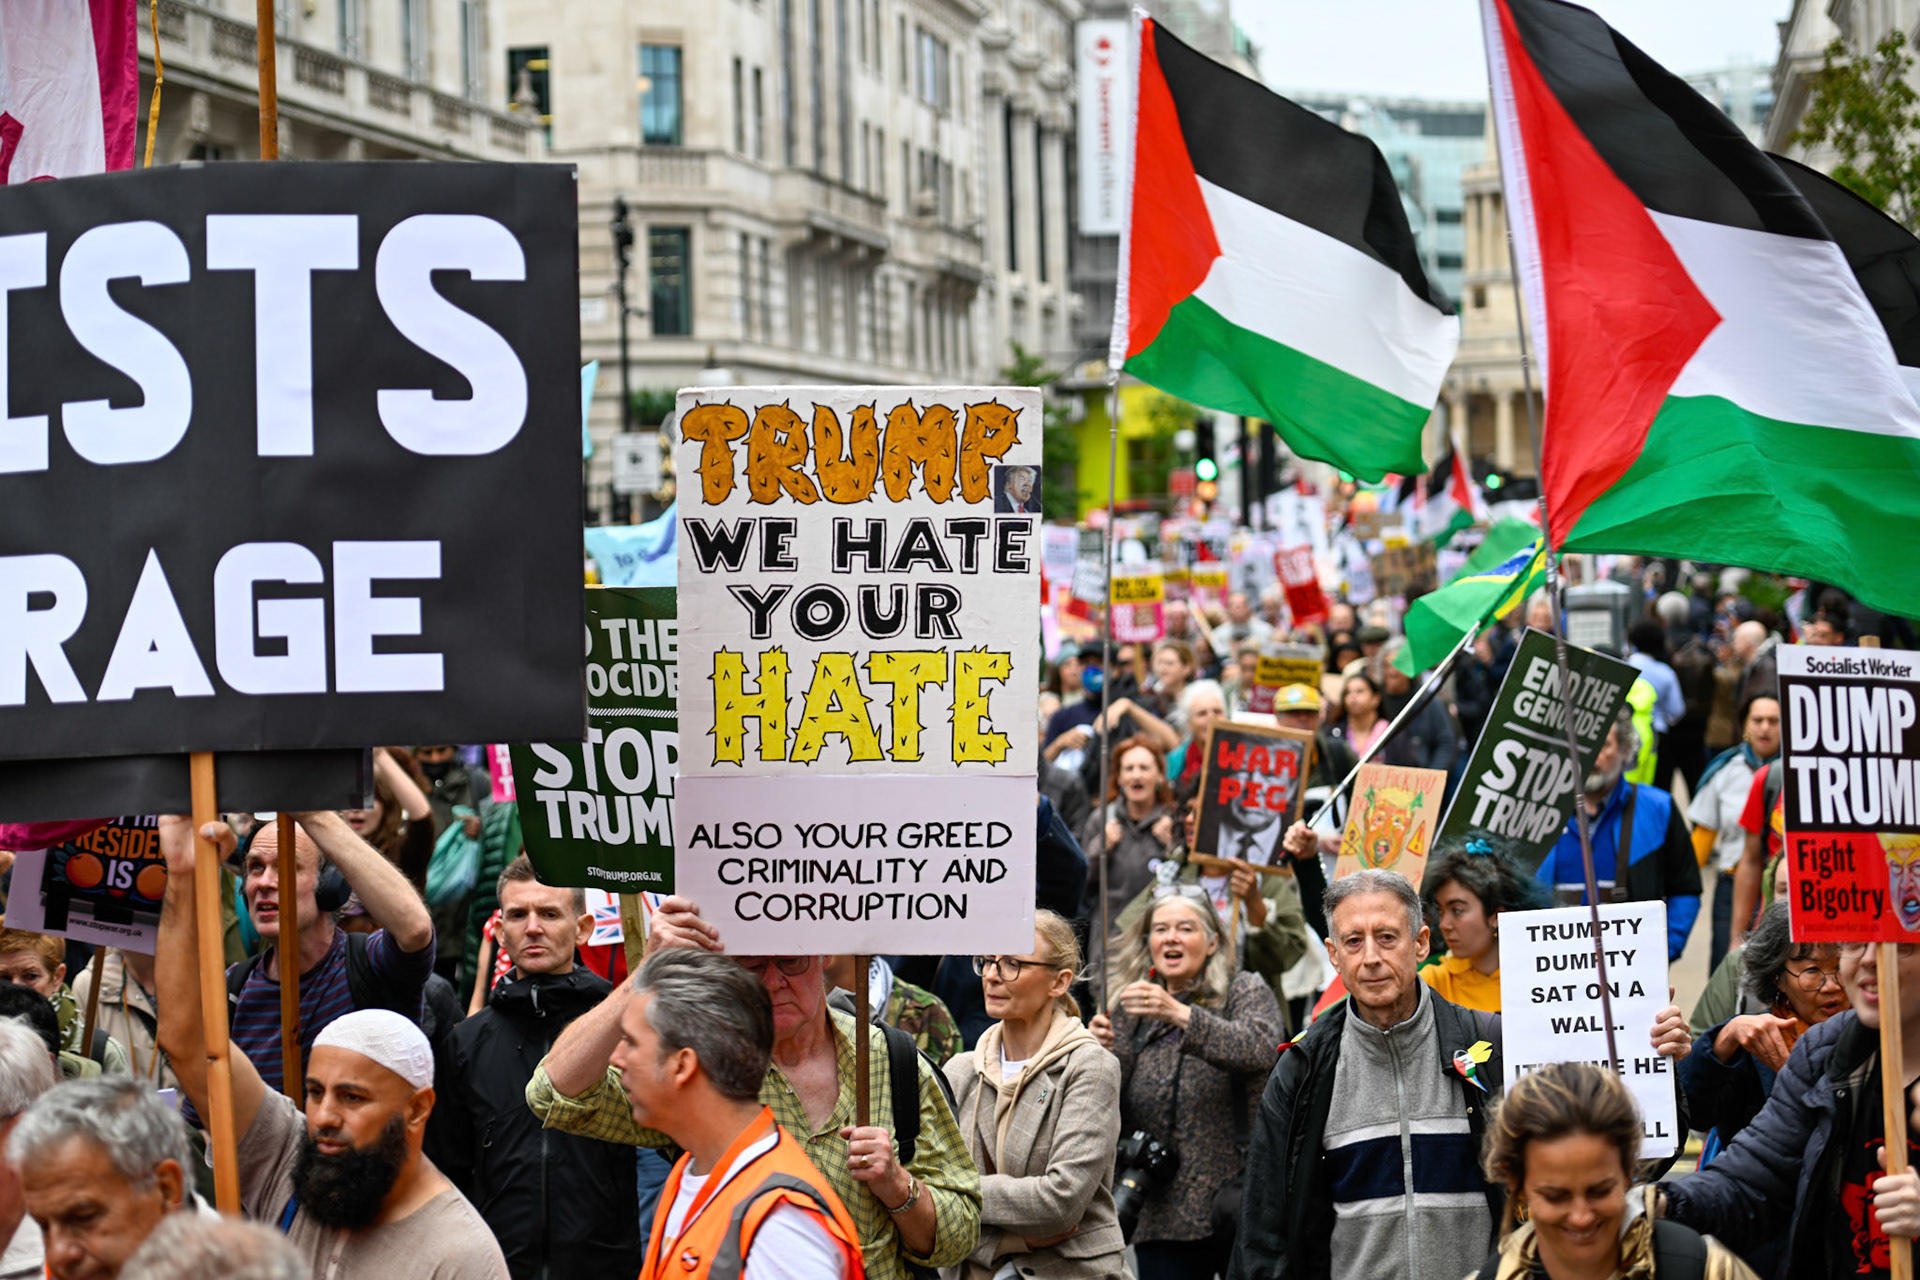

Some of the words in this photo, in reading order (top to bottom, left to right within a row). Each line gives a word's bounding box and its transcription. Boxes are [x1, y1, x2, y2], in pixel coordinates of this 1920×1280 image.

[680, 397, 1024, 505] TRUMP
[683, 517, 798, 573] WE
[832, 517, 1033, 574] HATE
[0, 540, 444, 705] RAGE
[726, 583, 963, 641] YOUR
[600, 618, 678, 661] THE
[1522, 656, 1581, 702] END
[1575, 676, 1621, 714] THE
[1806, 656, 1868, 675] Socialist
[1868, 658, 1912, 678] Worker
[706, 645, 1014, 767] HATE
[1788, 684, 1916, 754] DUMP
[530, 727, 679, 796] STOP
[1217, 740, 1298, 779] WAR
[1480, 739, 1582, 806] STOP
[1218, 777, 1288, 813] PIG
[1789, 756, 1920, 826] TRUM
[535, 789, 676, 847] TRUM
[1469, 784, 1561, 845] TRUMP
[689, 822, 782, 849] ALSO
[795, 823, 887, 849] YOUR
[897, 822, 1012, 848] GREED
[107, 859, 134, 889] IS
[717, 858, 928, 884] CRIMINALITY
[942, 858, 1008, 883] AND
[1797, 839, 1856, 879] Fight
[734, 891, 968, 921] CORRUPTION
[1801, 880, 1884, 919] Bigotry
[68, 917, 144, 937] www.stopwar.org.uk
[1526, 918, 1643, 942] TRUMPTY
[1531, 985, 1577, 1004] SAT
[1585, 982, 1620, 1000] ON
[1628, 980, 1645, 997] A
[1634, 1057, 1667, 1075] HE
